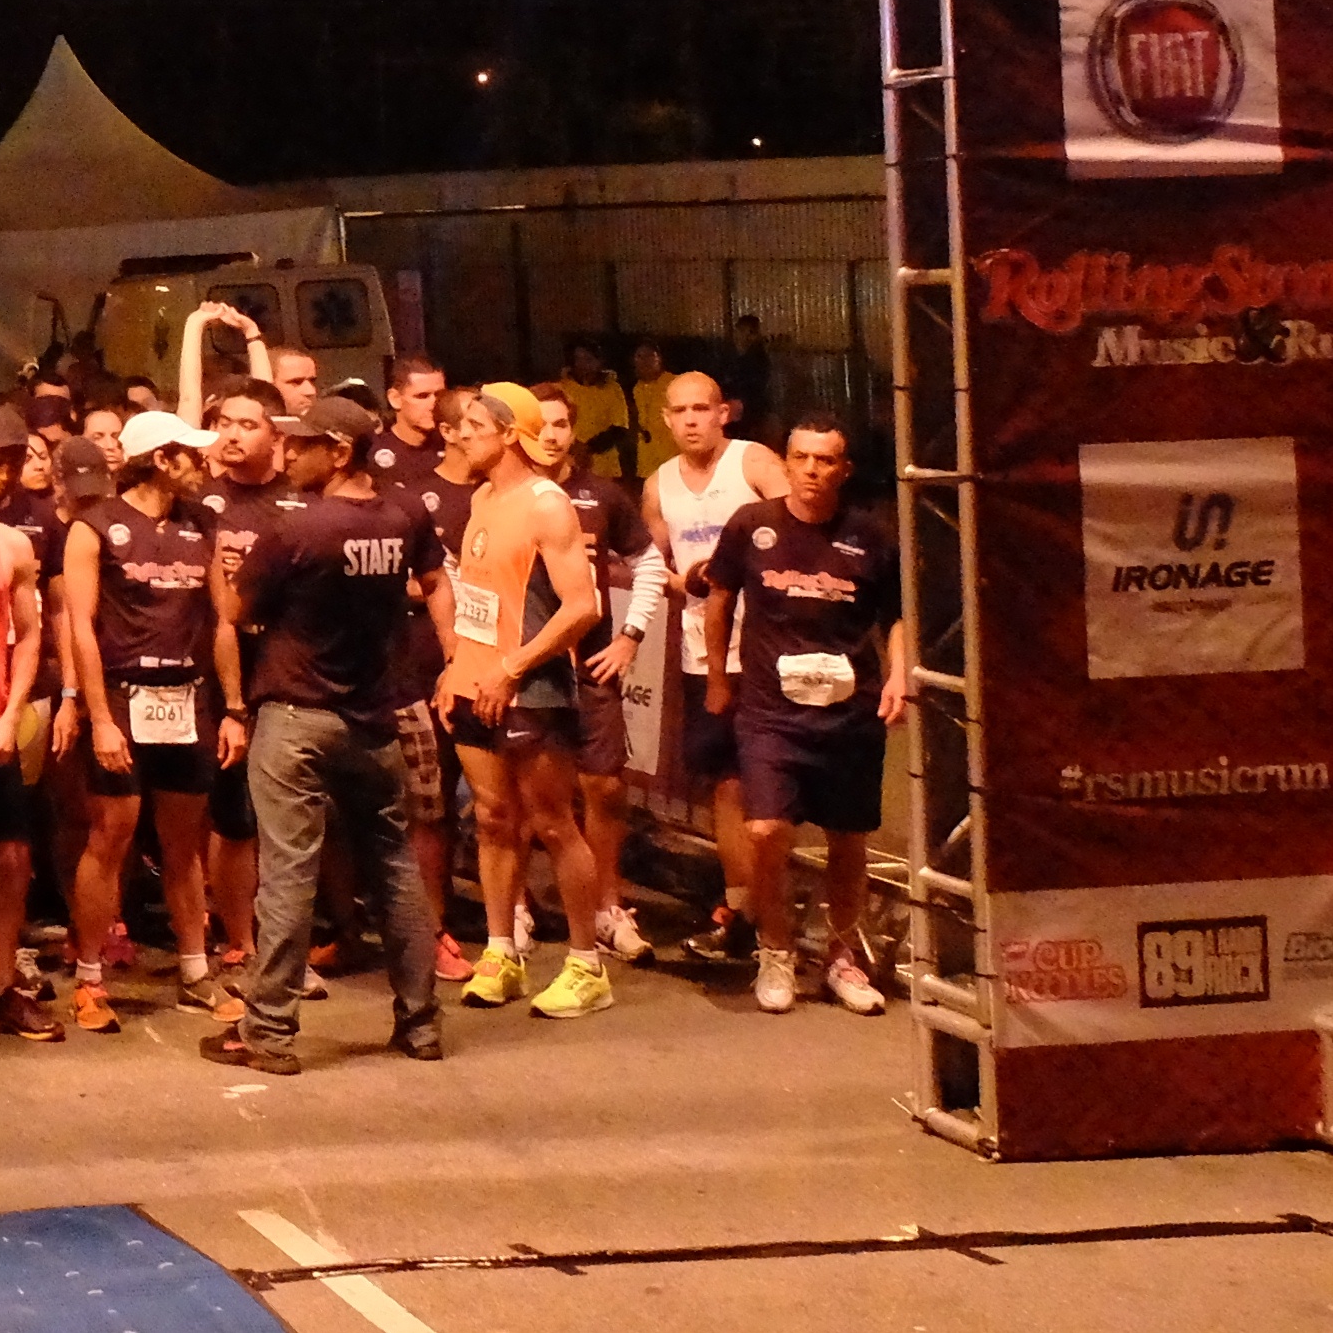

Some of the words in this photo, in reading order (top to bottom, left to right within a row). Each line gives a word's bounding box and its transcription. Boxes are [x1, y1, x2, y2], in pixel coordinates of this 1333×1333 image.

[1129, 31, 1209, 99] FIAT
[343, 537, 404, 576] STAFF
[1112, 560, 1275, 592] IRONAGE
[144, 704, 184, 721] 2061
[1059, 755, 1330, 805] #rsmusicrun
[1143, 929, 1205, 998] 89
